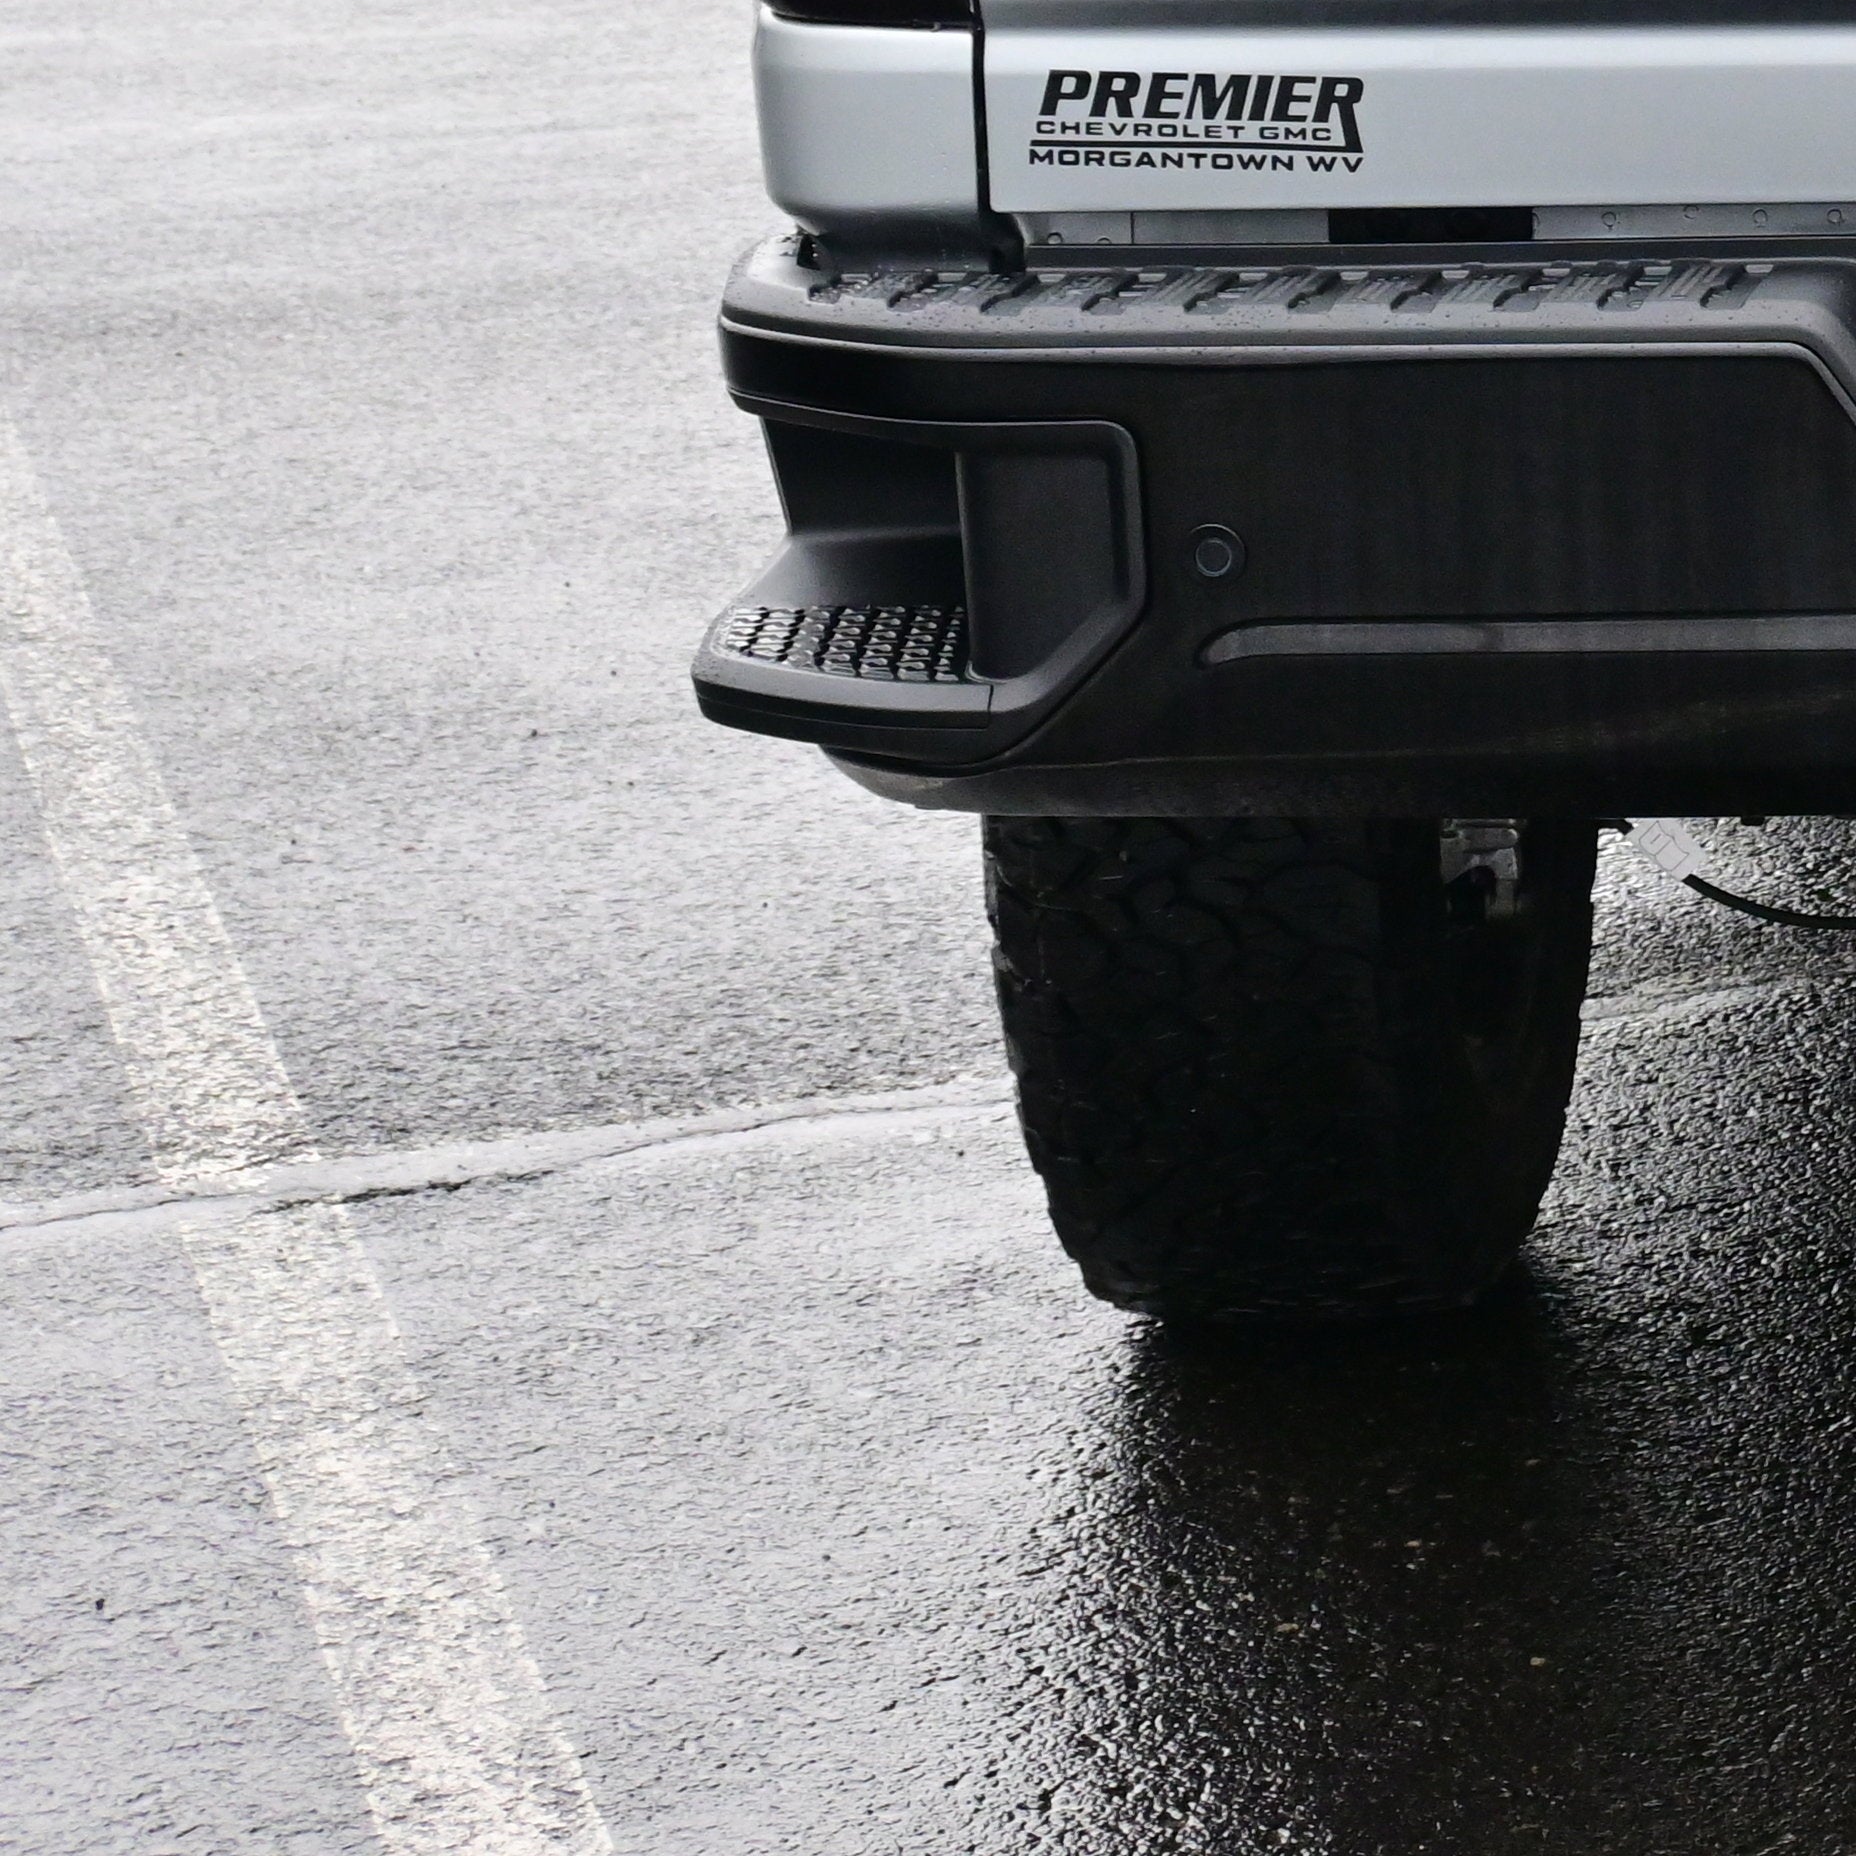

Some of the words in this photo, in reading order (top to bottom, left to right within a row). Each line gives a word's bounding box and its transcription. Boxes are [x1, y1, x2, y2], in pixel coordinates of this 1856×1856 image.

[1038, 69, 1365, 129] PREMIER
[1035, 120, 1246, 139] CHEVROLET
[1258, 125, 1332, 141] GMC
[1029, 148, 1295, 171] MORGANTOWN
[1305, 155, 1364, 173] WV
